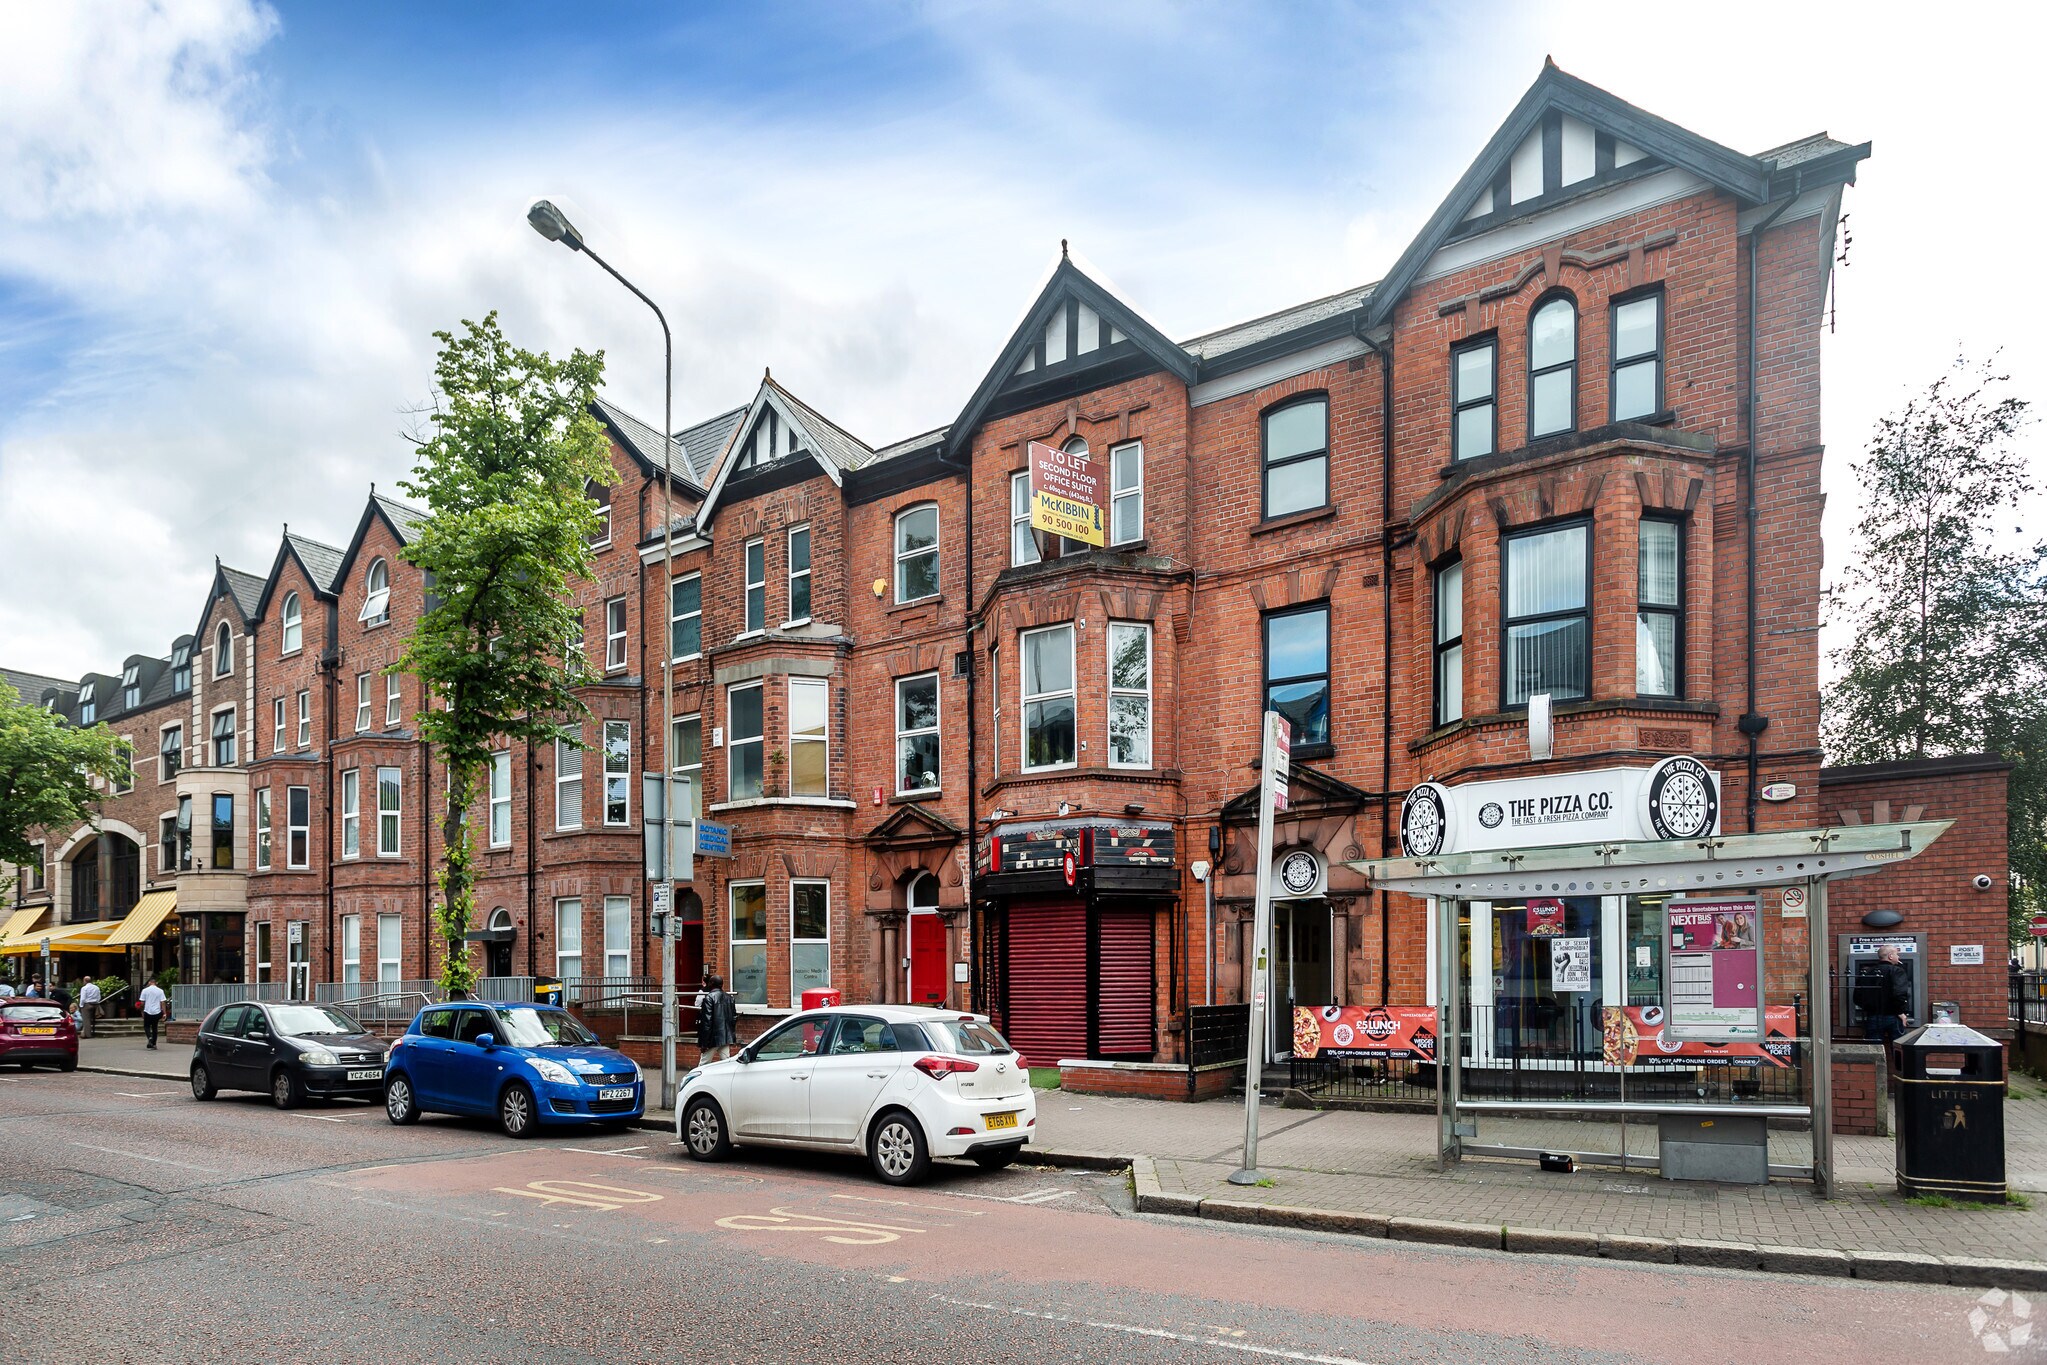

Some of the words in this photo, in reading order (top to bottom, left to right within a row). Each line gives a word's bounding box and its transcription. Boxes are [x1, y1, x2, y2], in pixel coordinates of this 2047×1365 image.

[1049, 450, 1065, 464] TO
[1067, 456, 1087, 472] LET
[1039, 460, 1071, 477] SECOND
[1072, 470, 1097, 486] FLOOR
[1043, 472, 1070, 487] OFFICE
[1071, 480, 1093, 495] SUITE
[1041, 495, 1089, 520] McKIBBIN
[1041, 514, 1053, 525] 90
[1056, 518, 1073, 530] 500
[1075, 524, 1089, 536] 100
[1661, 763, 1676, 777] THE
[1676, 760, 1695, 773] PIZZA
[1695, 767, 1706, 782] CO.
[1408, 793, 1417, 806] THE
[1416, 787, 1430, 797] PIZZA
[1429, 790, 1437, 802] CO.
[1508, 799, 1535, 817] THE
[1541, 794, 1582, 815] PIZZA
[1588, 792, 1613, 811] CO.
[1511, 817, 1521, 825] THE
[1523, 816, 1536, 824] FAST
[1543, 814, 1561, 823] FRESH
[1562, 812, 1580, 821] PIZZA
[1581, 810, 1609, 819] COMPANY
[699, 825, 728, 835] BOTANIC
[699, 833, 728, 845] MEDICAL
[699, 842, 726, 852] CENTRE
[1670, 914, 1698, 926] NEXT
[1356, 1021, 1369, 1030] £5
[1369, 1020, 1401, 1030] LUNCH
[364, 1071, 380, 1079] 4654
[601, 1090, 614, 1099] MFZ
[615, 1089, 631, 1098] 2267
[1931, 1090, 1979, 1100] LITTER
